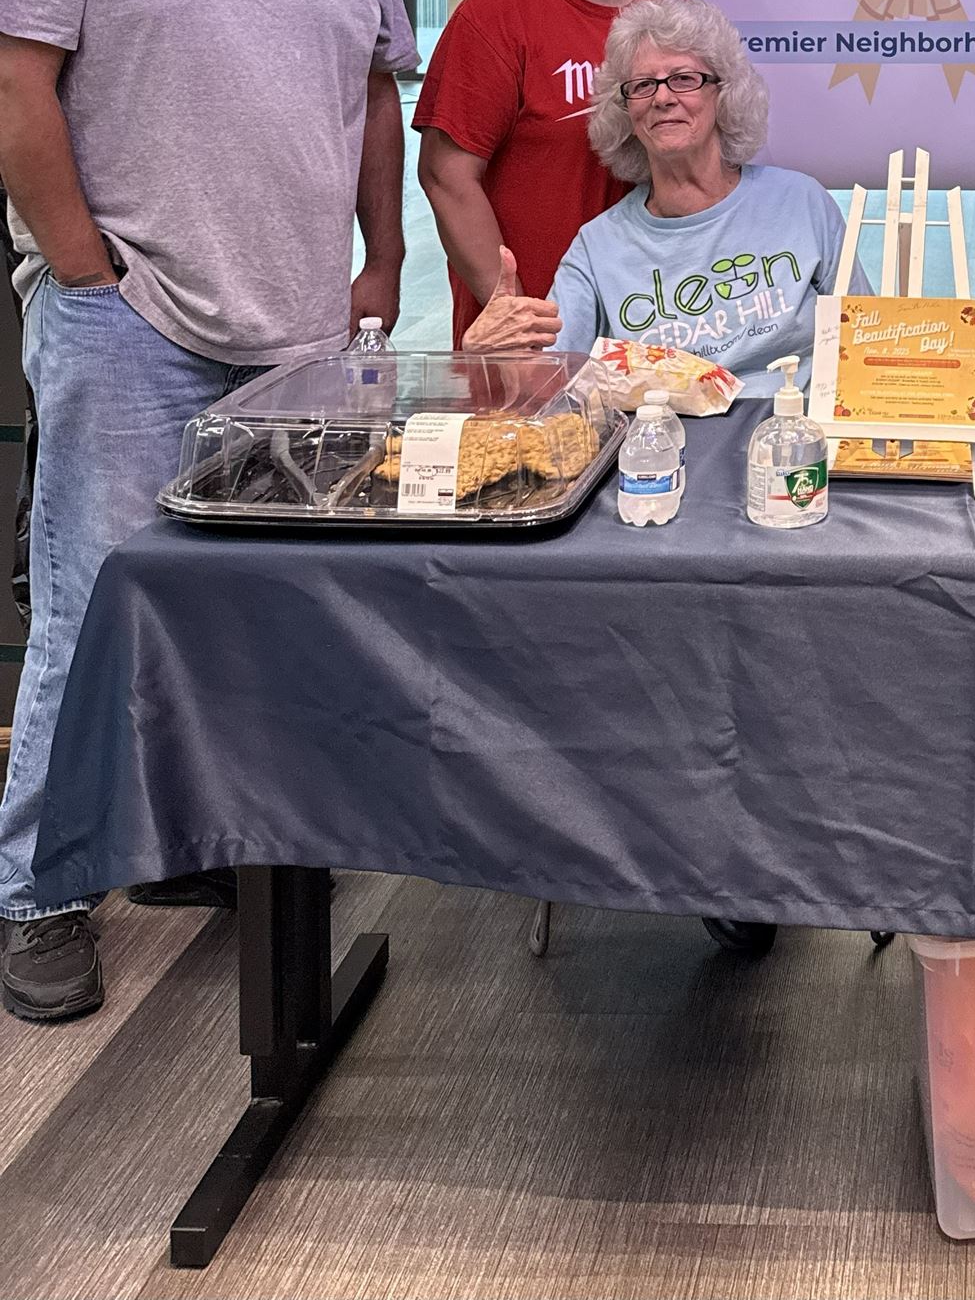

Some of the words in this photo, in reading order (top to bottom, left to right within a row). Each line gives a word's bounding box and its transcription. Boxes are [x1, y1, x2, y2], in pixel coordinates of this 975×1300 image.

[639, 309, 733, 349] CEDAR
[736, 288, 794, 326] HILL
[851, 310, 882, 329] Fall
[852, 320, 950, 345] Beautification
